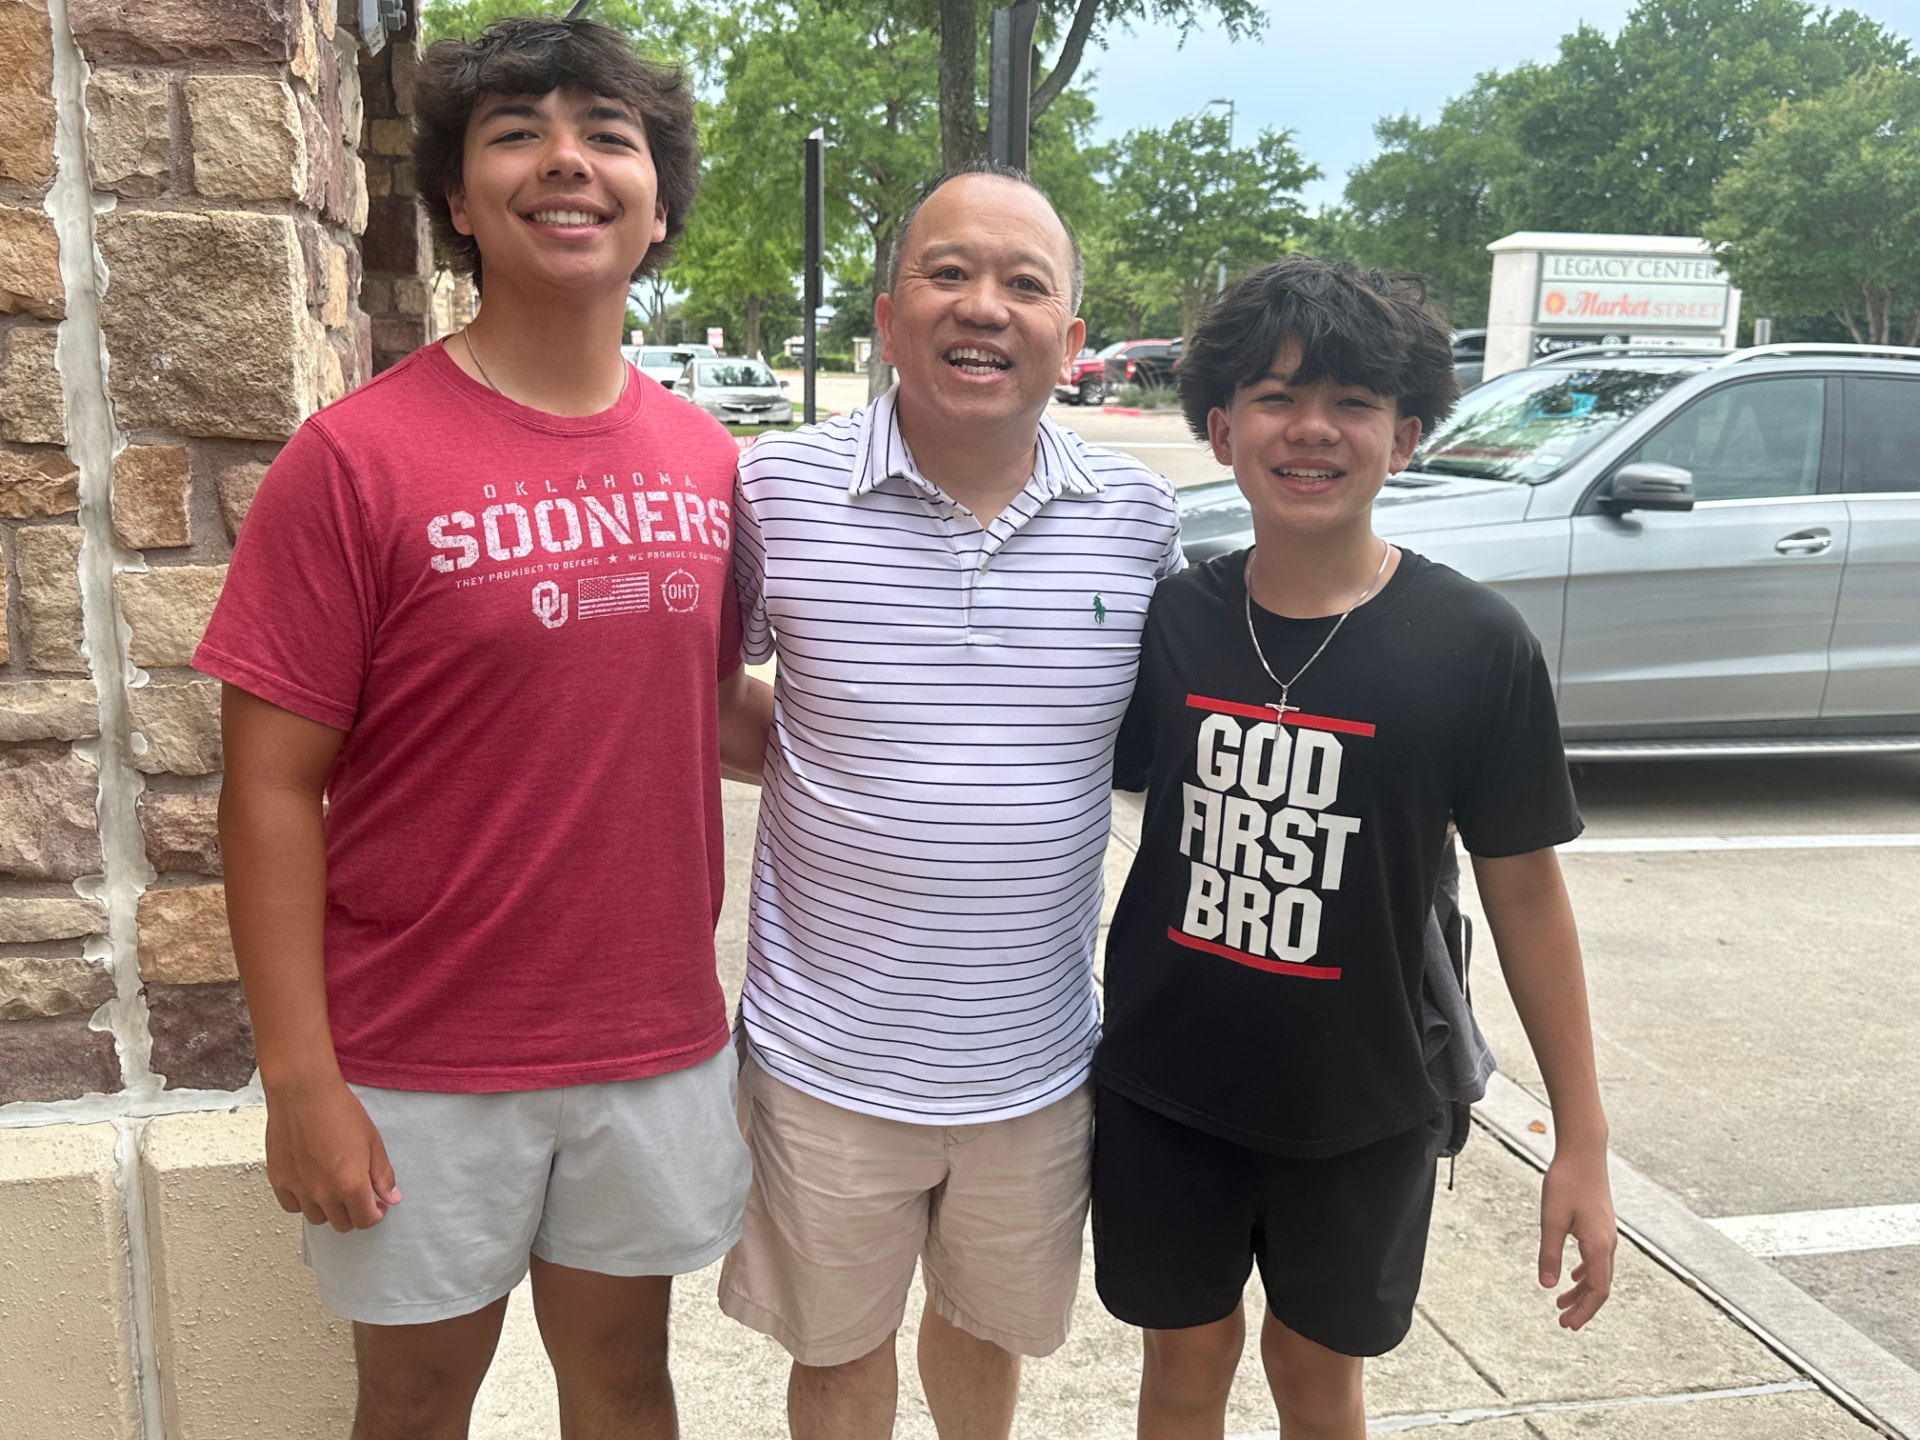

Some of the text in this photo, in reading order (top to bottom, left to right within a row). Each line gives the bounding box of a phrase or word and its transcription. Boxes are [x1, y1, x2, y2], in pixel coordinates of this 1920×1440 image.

[1554, 257, 1630, 278] LEGACY
[1567, 291, 1722, 319] Market STREET
[484, 472, 697, 499] OKLAHOMA
[427, 490, 730, 573] SOONERS
[455, 576, 484, 589] THEY
[489, 565, 544, 582] PROMISED
[547, 563, 559, 571] TO
[563, 557, 599, 569] DEFEND
[628, 553, 644, 561] WE
[647, 551, 686, 559] PROMISE
[668, 584, 696, 600] OHT
[1197, 713, 1343, 811] GOD
[1179, 781, 1361, 890] FIRST
[1182, 861, 1323, 963] BRO
